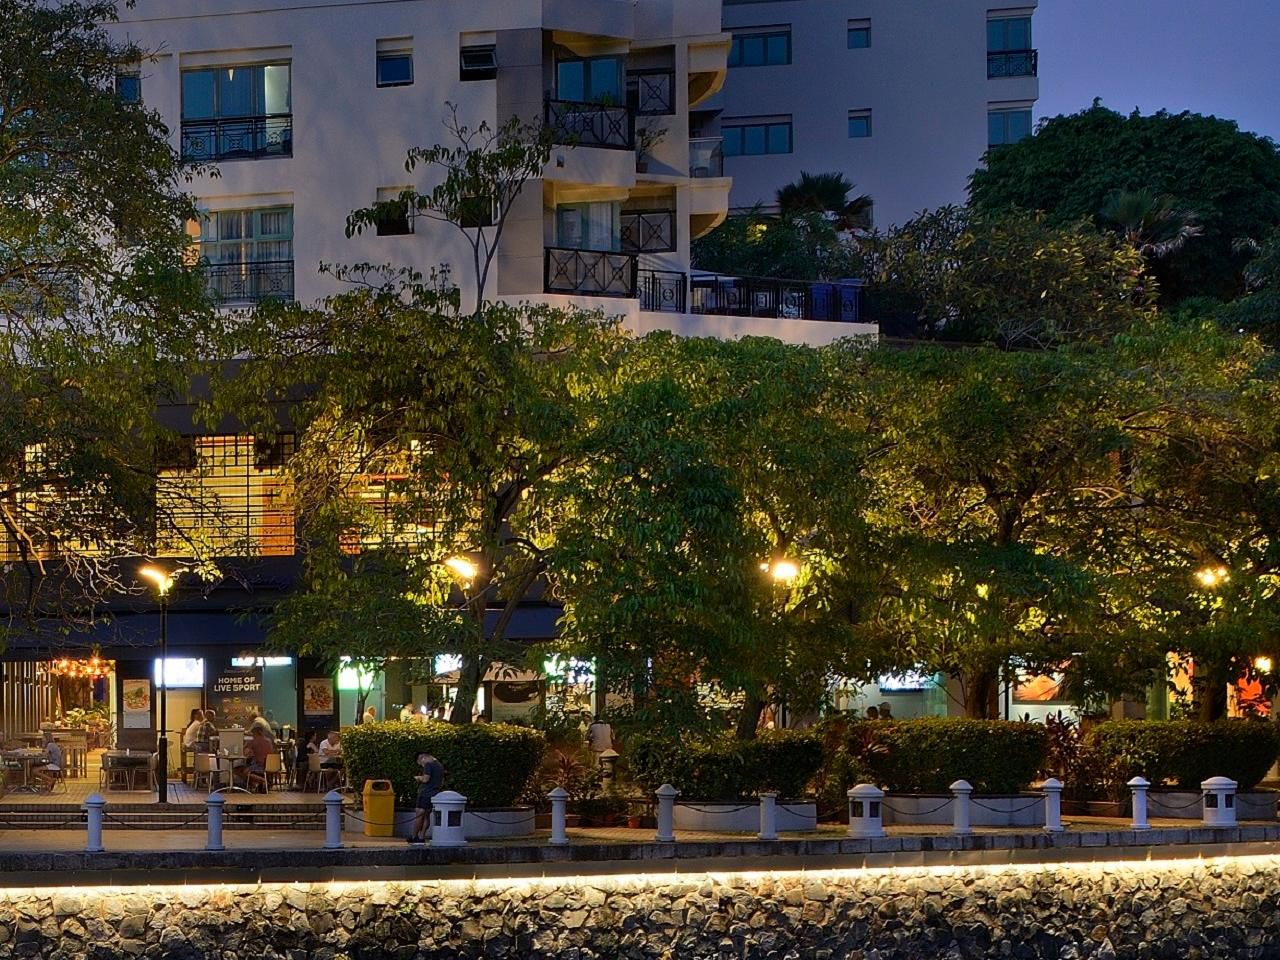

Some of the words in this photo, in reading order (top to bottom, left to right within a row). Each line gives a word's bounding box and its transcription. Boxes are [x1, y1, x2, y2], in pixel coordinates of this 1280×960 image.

[243, 676, 256, 684] OF
[213, 684, 232, 692] LIVE
[232, 683, 261, 692] SPORT
